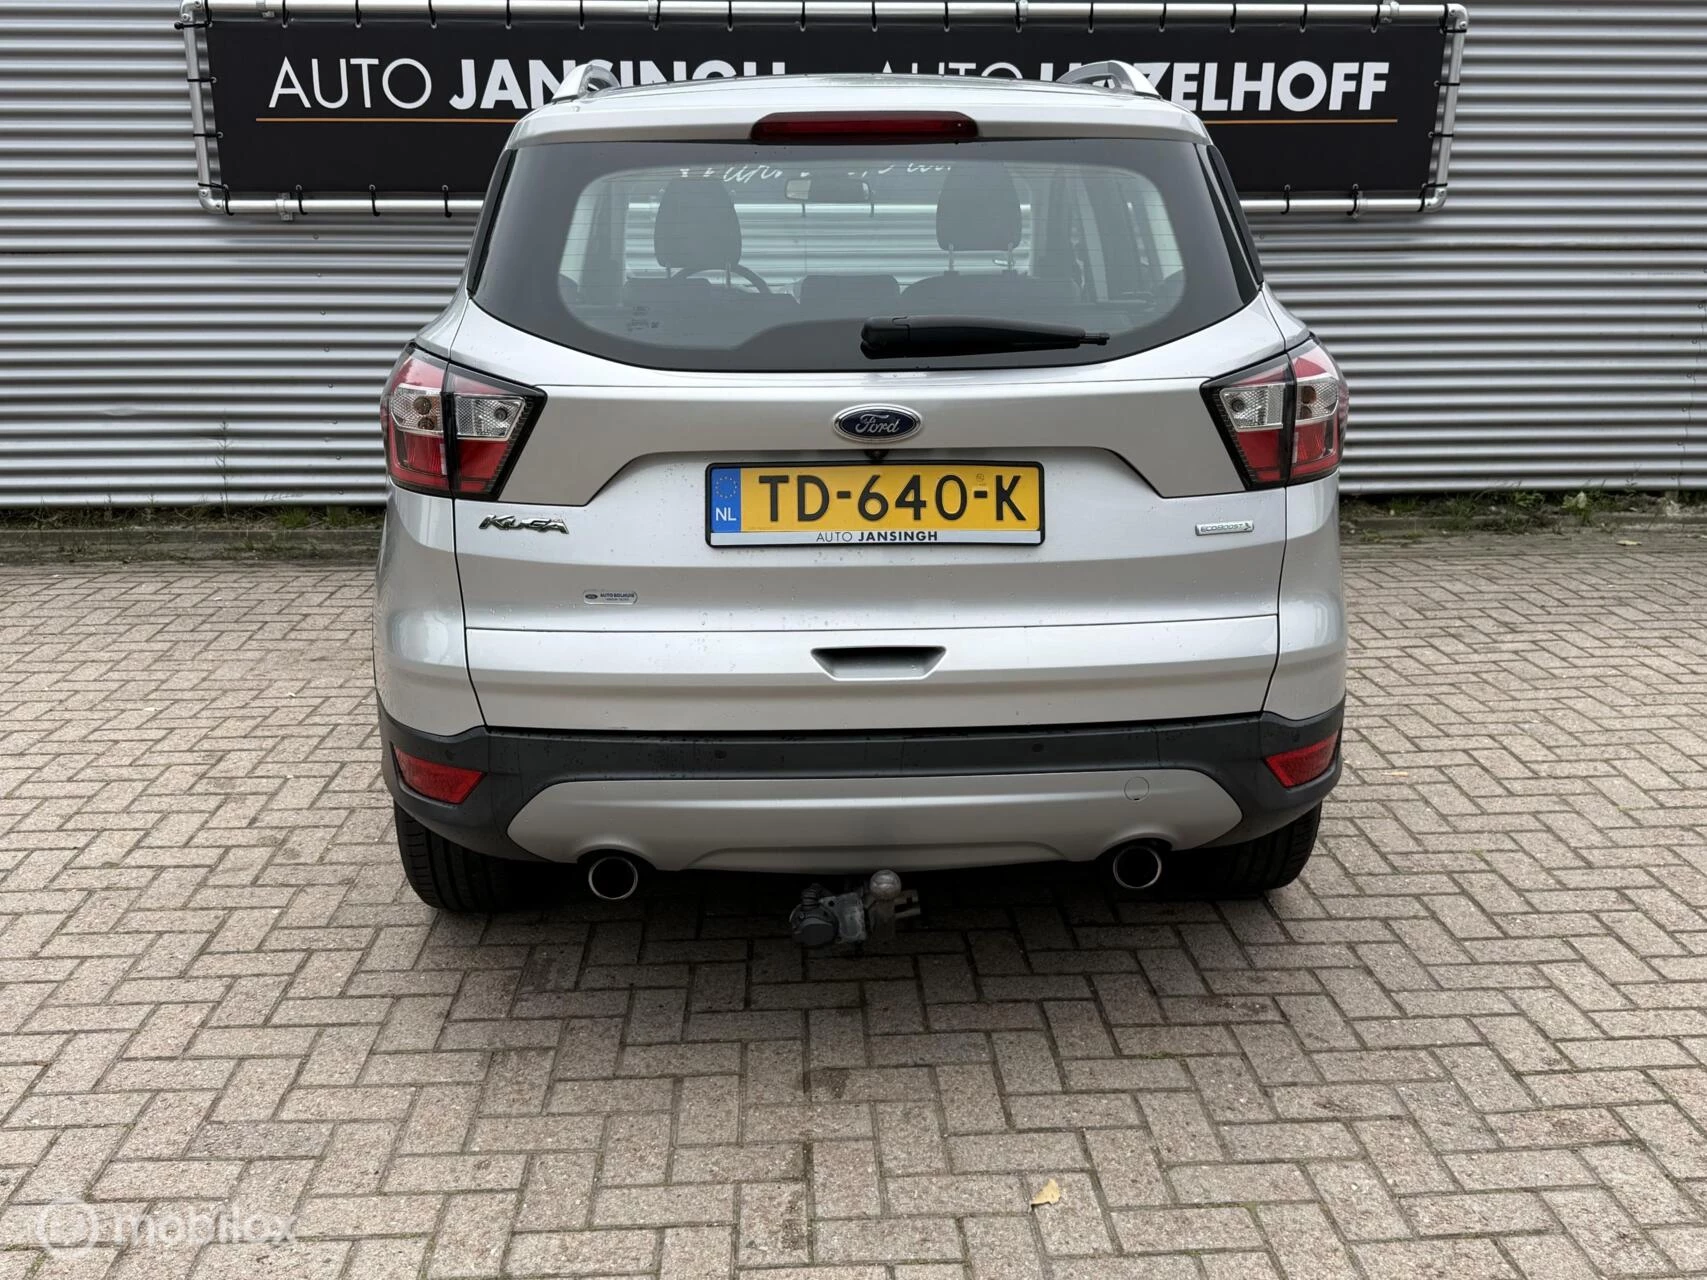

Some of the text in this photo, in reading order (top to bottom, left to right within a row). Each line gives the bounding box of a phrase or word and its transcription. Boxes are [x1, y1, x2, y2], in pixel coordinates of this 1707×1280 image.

[269, 56, 432, 110] AUTO
[854, 412, 900, 434] Ford
[758, 474, 1027, 522] TD-640-K
[715, 507, 737, 521] NL
[816, 530, 938, 543] AUTO JANSINGH
[1200, 523, 1244, 533] ECOBOOST
